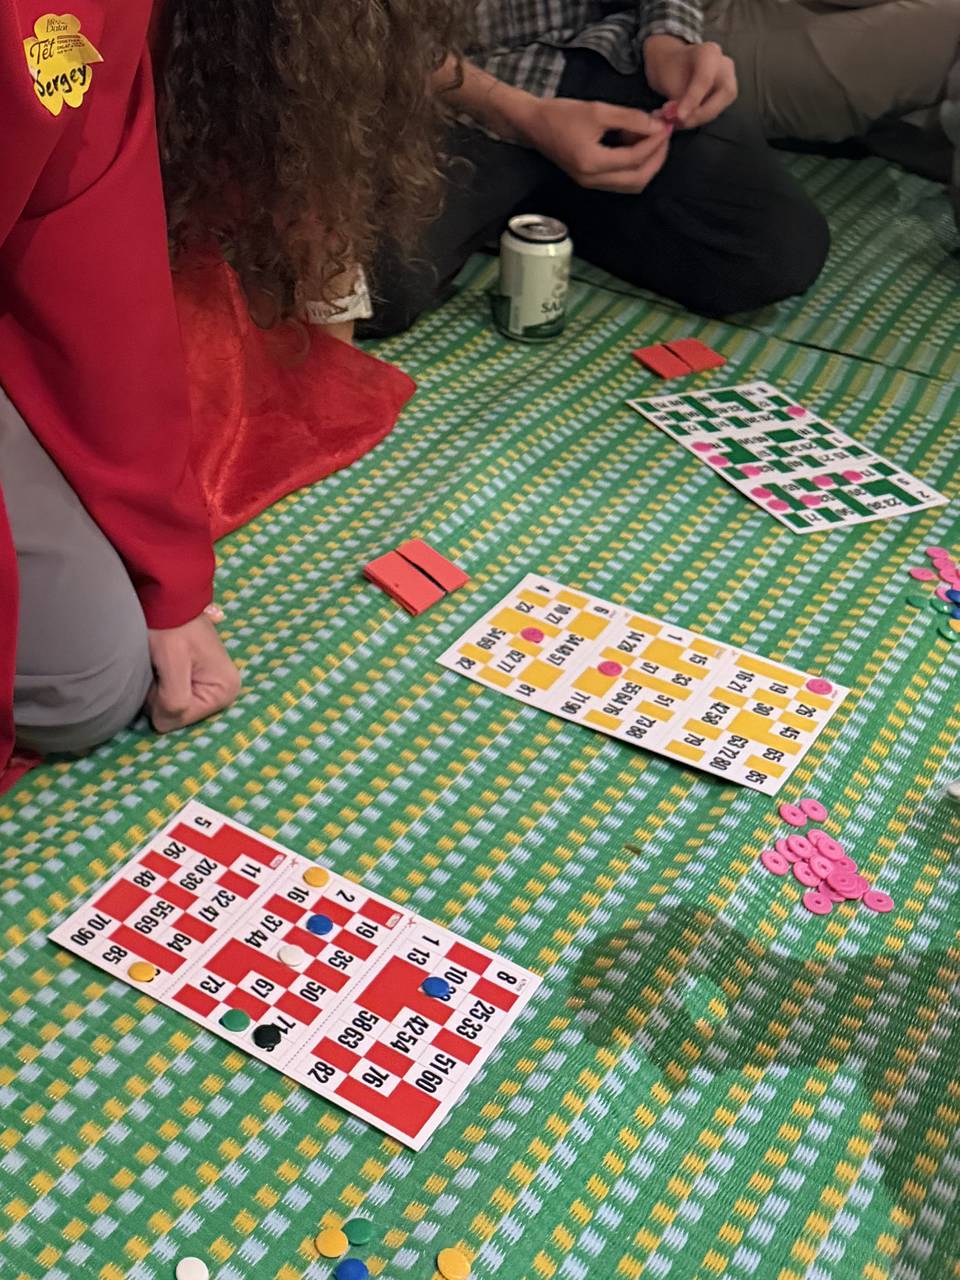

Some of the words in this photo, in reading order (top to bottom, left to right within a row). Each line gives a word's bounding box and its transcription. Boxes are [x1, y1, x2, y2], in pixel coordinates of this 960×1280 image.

[36, 64, 88, 97] Sergey
[516, 602, 534, 613] 23
[546, 613, 563, 624] 27
[487, 628, 506, 640] 54
[566, 634, 584, 646] 34
[627, 632, 644, 642] 14
[668, 633, 682, 641] 1
[477, 637, 496, 649] 69
[456, 657, 476, 669] 82
[547, 654, 565, 666] 57
[689, 654, 707, 665] 15
[497, 661, 515, 673] 77
[641, 663, 659, 674] 37
[672, 674, 692, 686] 33
[736, 671, 754, 682] 16
[517, 685, 536, 696] 81
[622, 683, 642, 695] 55
[728, 681, 747, 693] 21
[769, 683, 788, 694] 19
[571, 692, 590, 703] 71
[612, 693, 632, 705] 64
[654, 695, 674, 707] 51
[603, 704, 623, 715] 76
[710, 702, 730, 714] 42
[753, 703, 774, 716] 30
[796, 704, 816, 717] 26
[636, 716, 656, 728] 73
[701, 712, 723, 725] 58
[626, 726, 647, 739] 88
[779, 727, 800, 740] 45
[684, 734, 705, 746] 79
[727, 735, 749, 749] 63
[718, 746, 740, 759] 72
[762, 748, 784, 762] 65
[709, 757, 731, 770] 80
[745, 770, 767, 784] 85
[195, 817, 212, 828] 5
[163, 842, 186, 859] 26
[194, 858, 217, 876] 20
[241, 864, 261, 878] 11
[133, 871, 156, 887] 48
[180, 873, 203, 890] 39
[211, 890, 236, 908] 32
[287, 887, 309, 903] 16
[336, 890, 355, 902] 2
[150, 901, 175, 919] 55
[199, 906, 219, 922] 47
[88, 914, 112, 931] 70
[134, 916, 159, 934] 69
[260, 915, 283, 933] 37
[71, 928, 95, 946] 90
[356, 922, 378, 938] 19
[167, 933, 191, 952] 64
[244, 930, 268, 948] 44
[422, 936, 439, 946] 1
[102, 945, 127, 964] 85
[328, 950, 354, 970] 35
[407, 948, 430, 965] 13
[444, 967, 467, 984] 10
[497, 971, 517, 984] 8
[200, 975, 225, 994] 73
[251, 979, 274, 998] 67
[300, 982, 326, 1002] 50
[469, 1000, 495, 1022] 25
[271, 1015, 296, 1035] 71
[352, 1011, 379, 1032] 58
[403, 1016, 429, 1035] 42
[456, 1018, 483, 1039] 33
[338, 1027, 364, 1049] 63
[390, 1031, 418, 1053] 54
[429, 1054, 456, 1075] 51
[307, 1061, 335, 1083] 82
[362, 1066, 389, 1088] 76
[415, 1070, 443, 1093] 60
